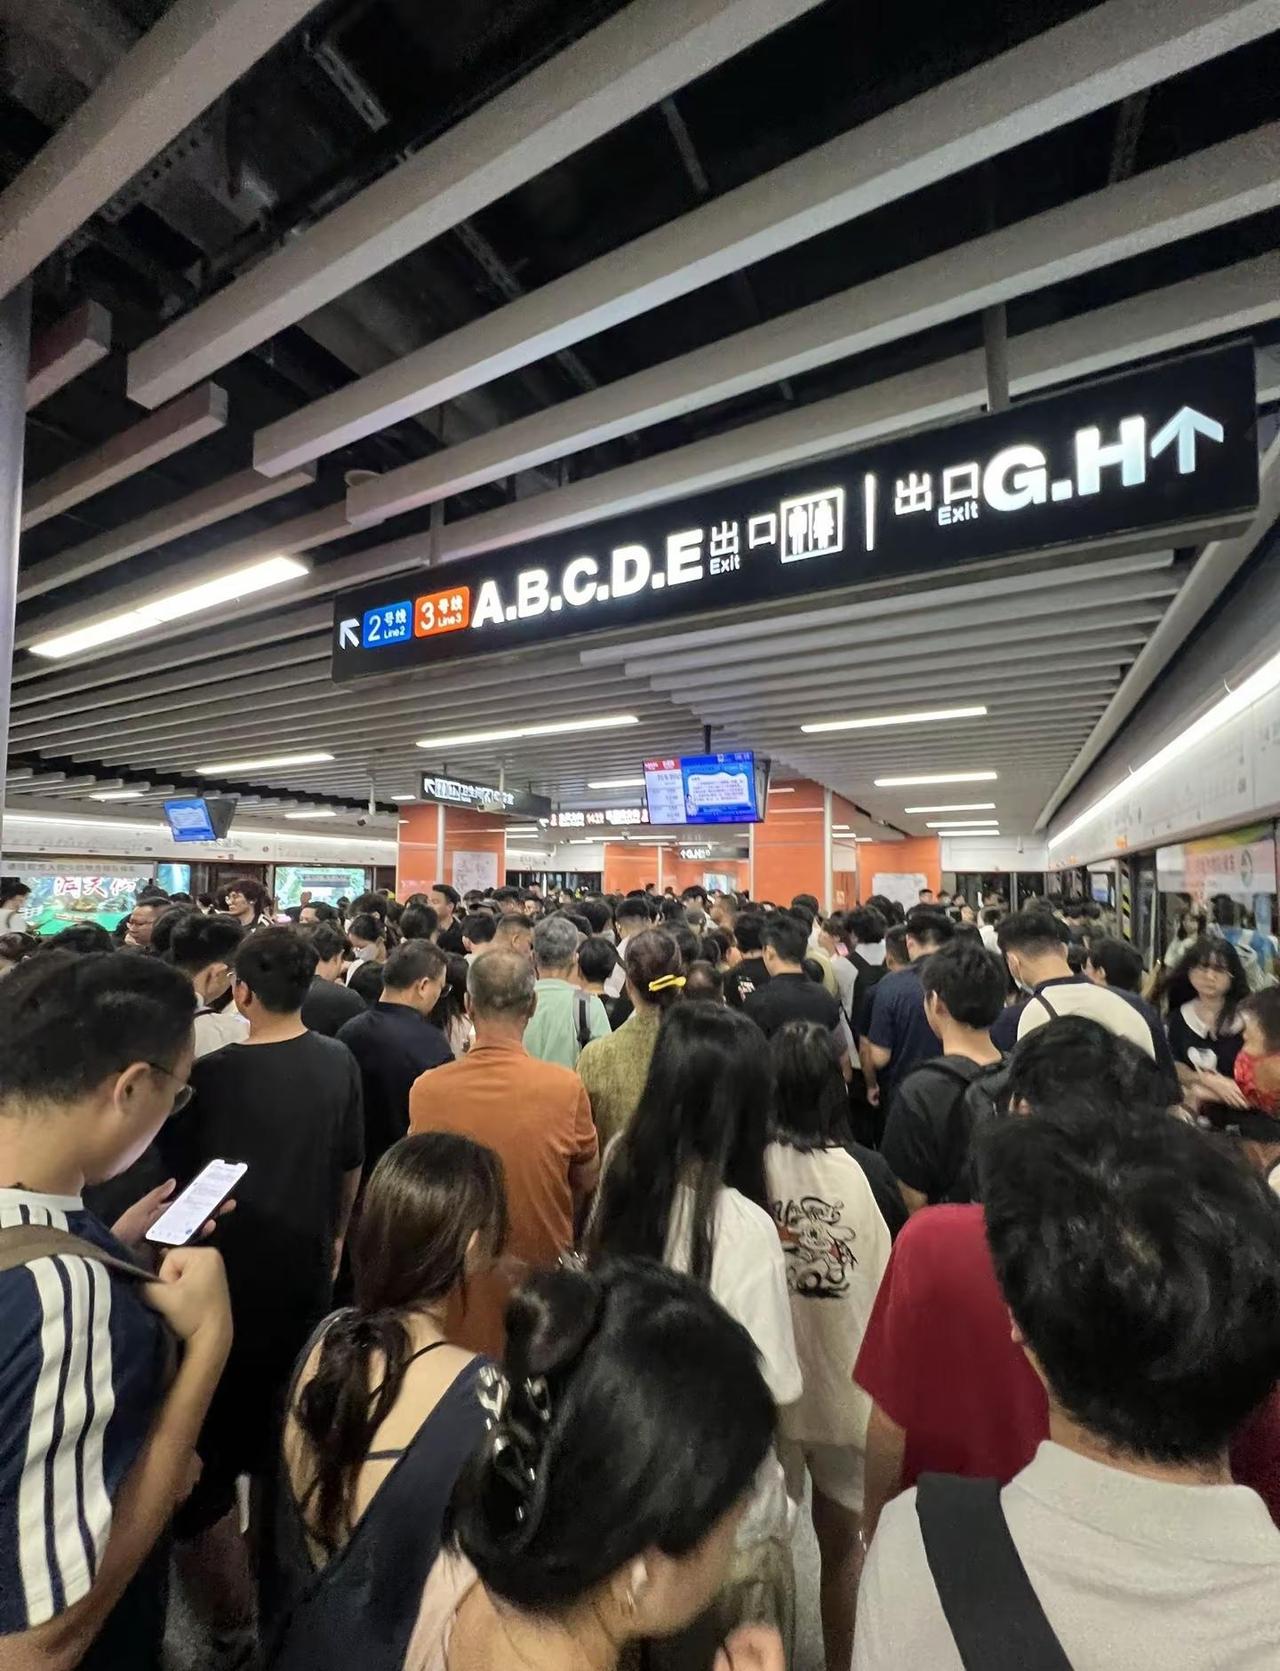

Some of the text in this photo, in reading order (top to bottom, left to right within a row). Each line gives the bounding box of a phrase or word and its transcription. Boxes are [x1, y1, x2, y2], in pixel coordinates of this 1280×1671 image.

[983, 413, 1146, 512] G.H
[895, 462, 979, 515] 出口
[938, 500, 979, 526] Exit
[710, 513, 777, 558] 出口
[471, 528, 704, 629] A.B.C.D.E
[710, 554, 740, 576] Exit
